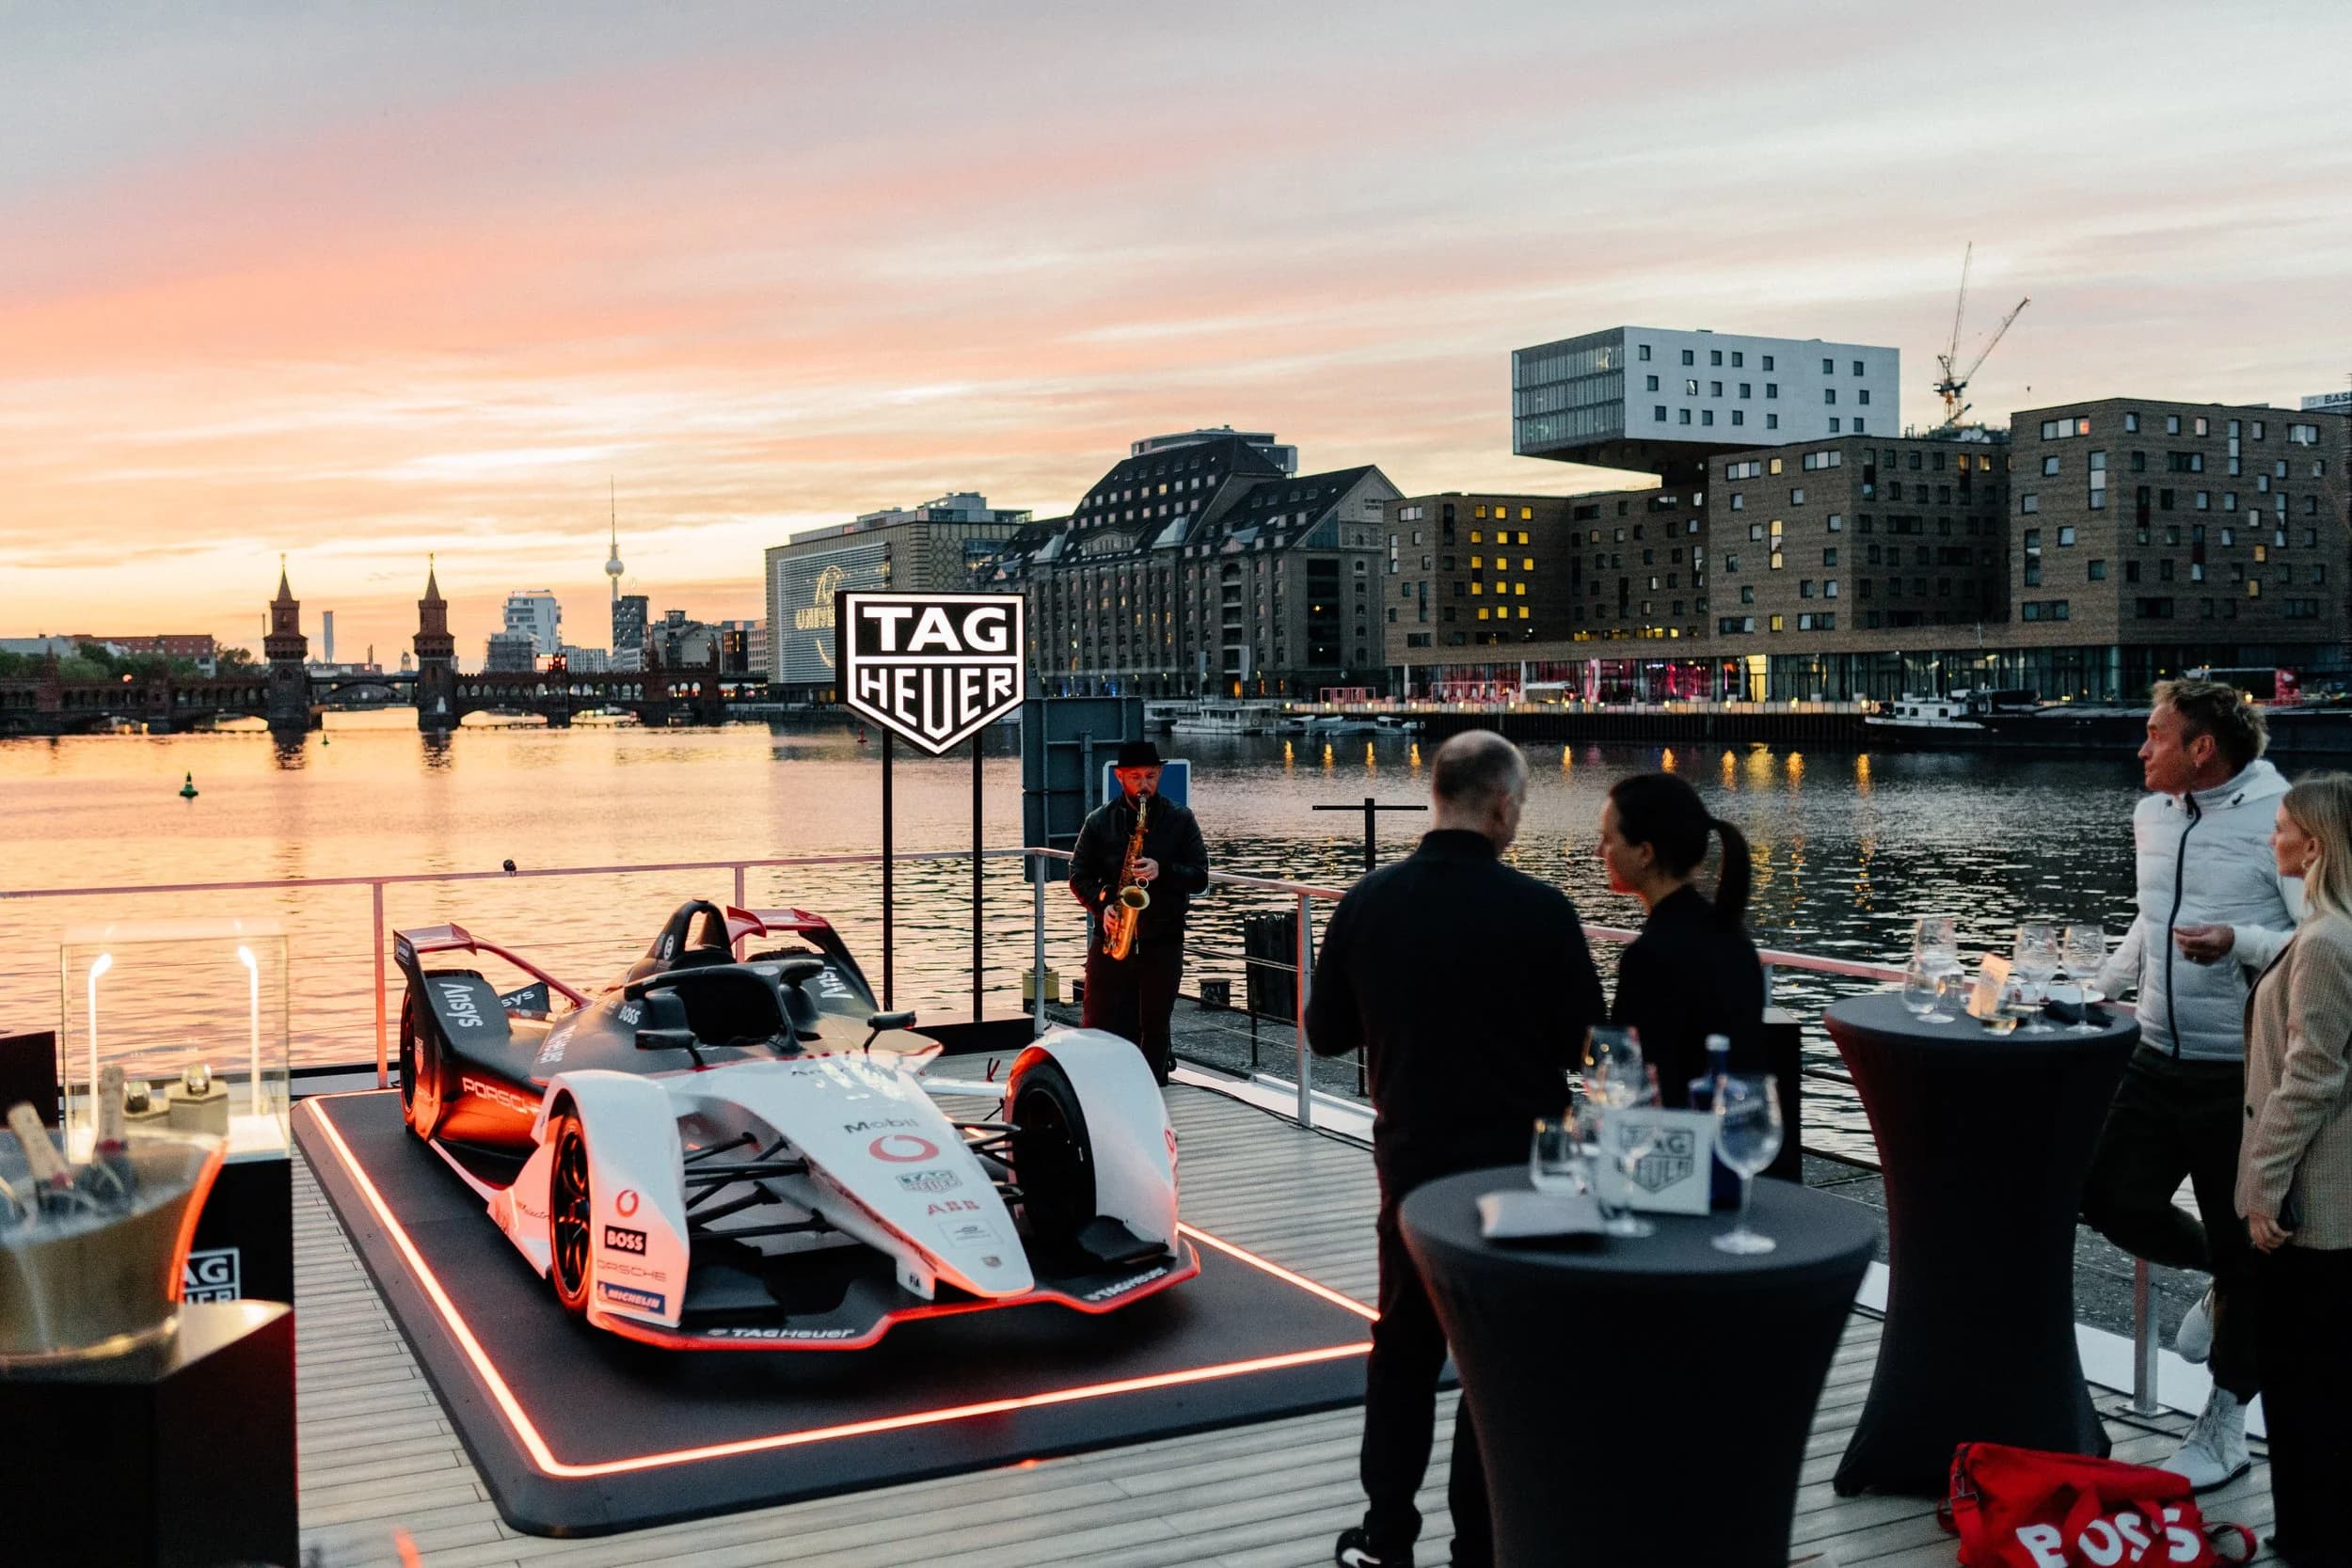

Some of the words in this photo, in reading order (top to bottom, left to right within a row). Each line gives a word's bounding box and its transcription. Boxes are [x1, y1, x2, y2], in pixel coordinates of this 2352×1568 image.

[2325, 391, 2352, 404] BAS
[863, 607, 1008, 652] TAG
[861, 667, 1012, 740] HEUER
[438, 982, 485, 1028] Ansys
[618, 1006, 642, 1025] BOSS
[843, 1118, 919, 1133] Mobil
[928, 1200, 980, 1216] ABB
[607, 1230, 644, 1251] BOSS
[608, 1290, 660, 1308] MICHELIN
